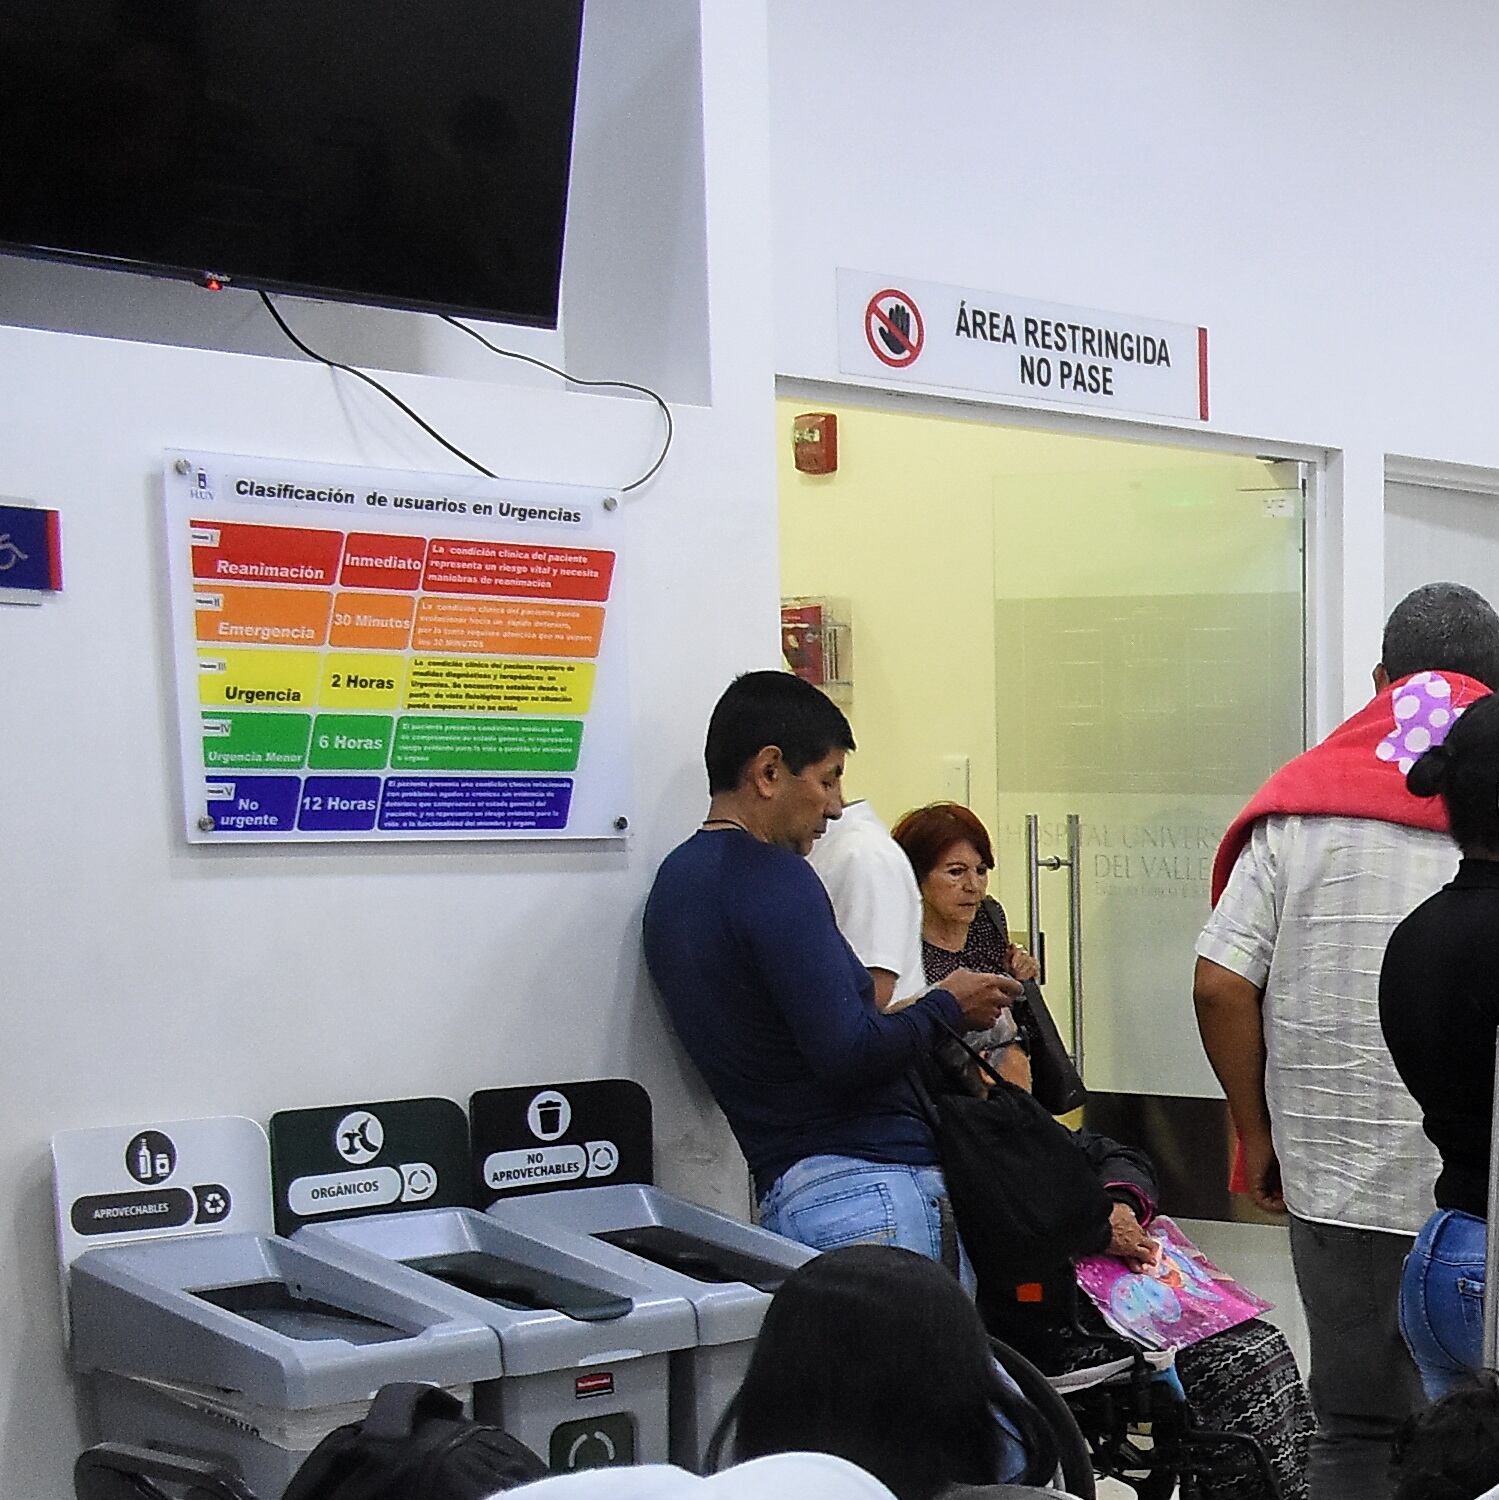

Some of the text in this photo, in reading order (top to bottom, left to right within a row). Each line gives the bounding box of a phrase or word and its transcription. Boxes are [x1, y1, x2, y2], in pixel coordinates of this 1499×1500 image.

[956, 301, 1171, 369] ÁREA RESTRINGIDA
[1020, 354, 1114, 396] NO PASE
[235, 479, 581, 522] Clasificación de usuarios en Urgencias
[216, 559, 325, 580] Reanimación
[345, 553, 421, 571] Inmediato
[334, 613, 351, 626] 30
[355, 615, 410, 629] Minutos
[218, 622, 315, 639] Emergencia
[331, 674, 394, 689] 2 Horas
[225, 686, 302, 704] Urgencia
[319, 736, 382, 750] 6 Horas
[208, 752, 302, 764] Urgencia Menor
[238, 798, 259, 811] No
[303, 797, 322, 810] 12
[327, 797, 376, 811] Horas
[220, 815, 278, 828] urgente
[1141, 855, 1210, 881] VALLE
[526, 1153, 544, 1166] NO
[491, 1160, 580, 1183] APROVECHABLES
[310, 1179, 380, 1201] ORGÁNICOS
[92, 1202, 170, 1220] APROVECHABLES
